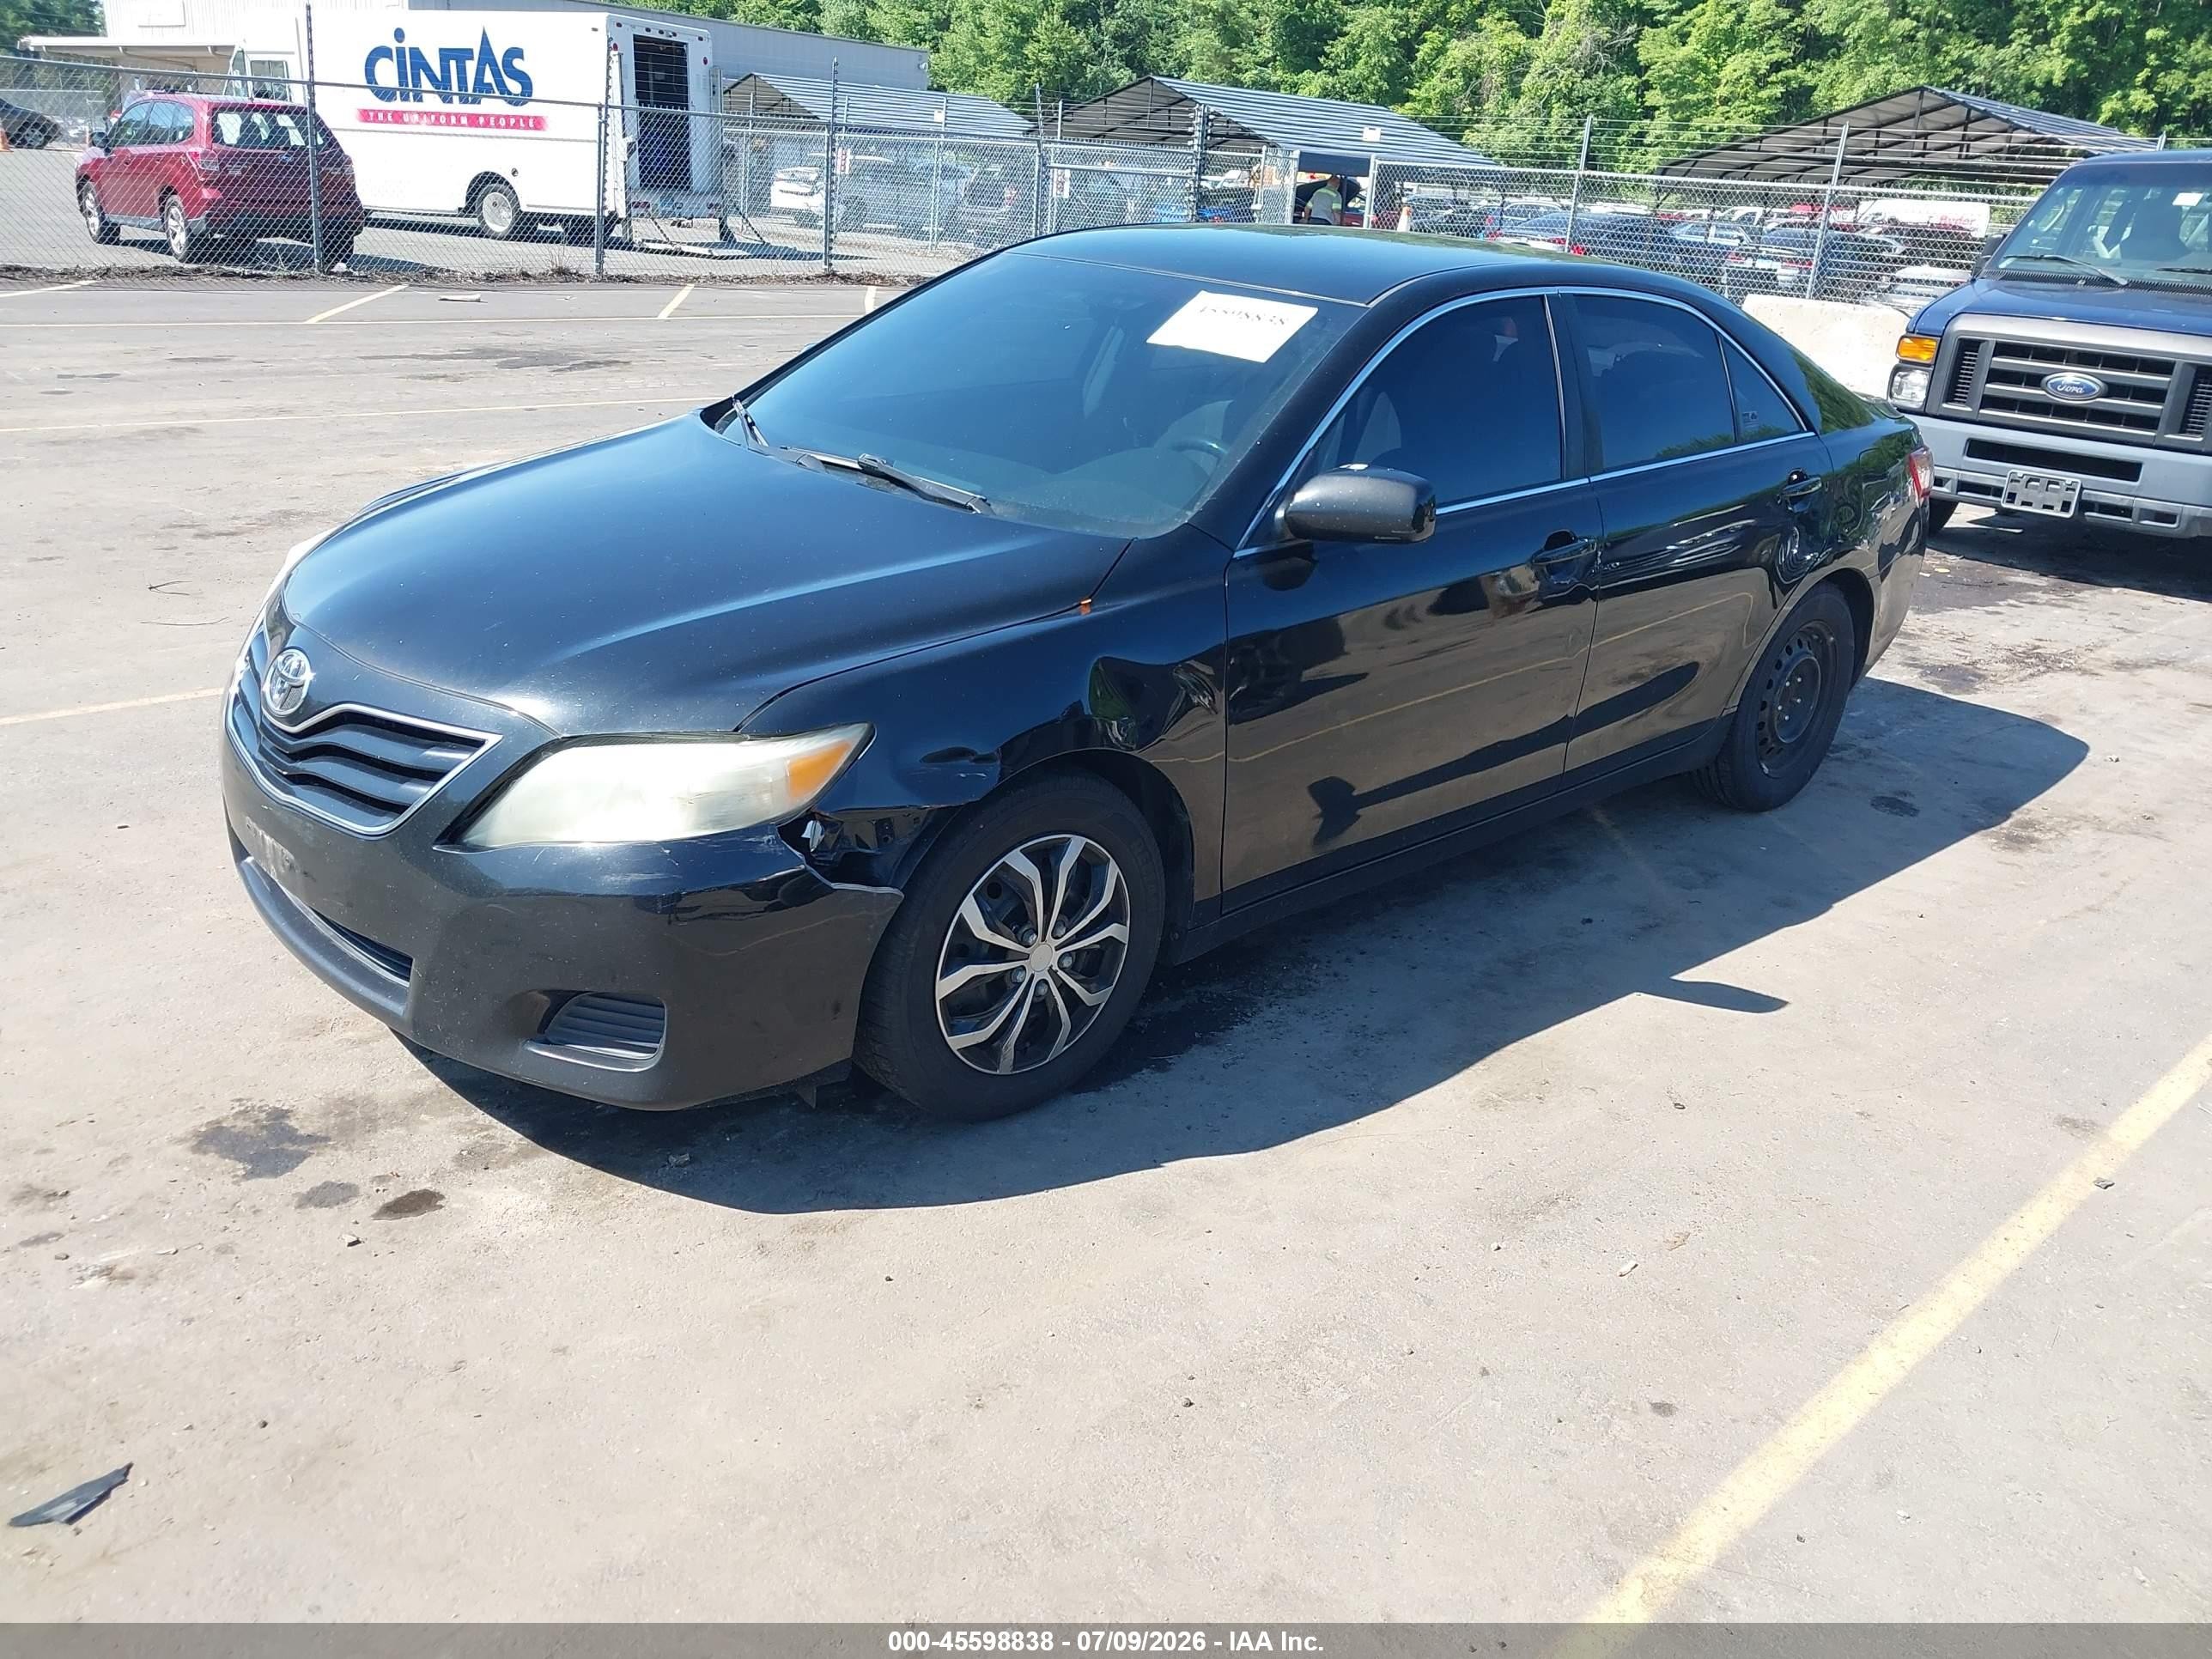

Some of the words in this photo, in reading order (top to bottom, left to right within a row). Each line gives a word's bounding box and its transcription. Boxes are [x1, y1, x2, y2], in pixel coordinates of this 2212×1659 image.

[368, 112, 393, 122] THE
[403, 113, 468, 125] UNIFORM
[478, 116, 535, 128] PEOPLE
[2057, 379, 2086, 394] Ford
